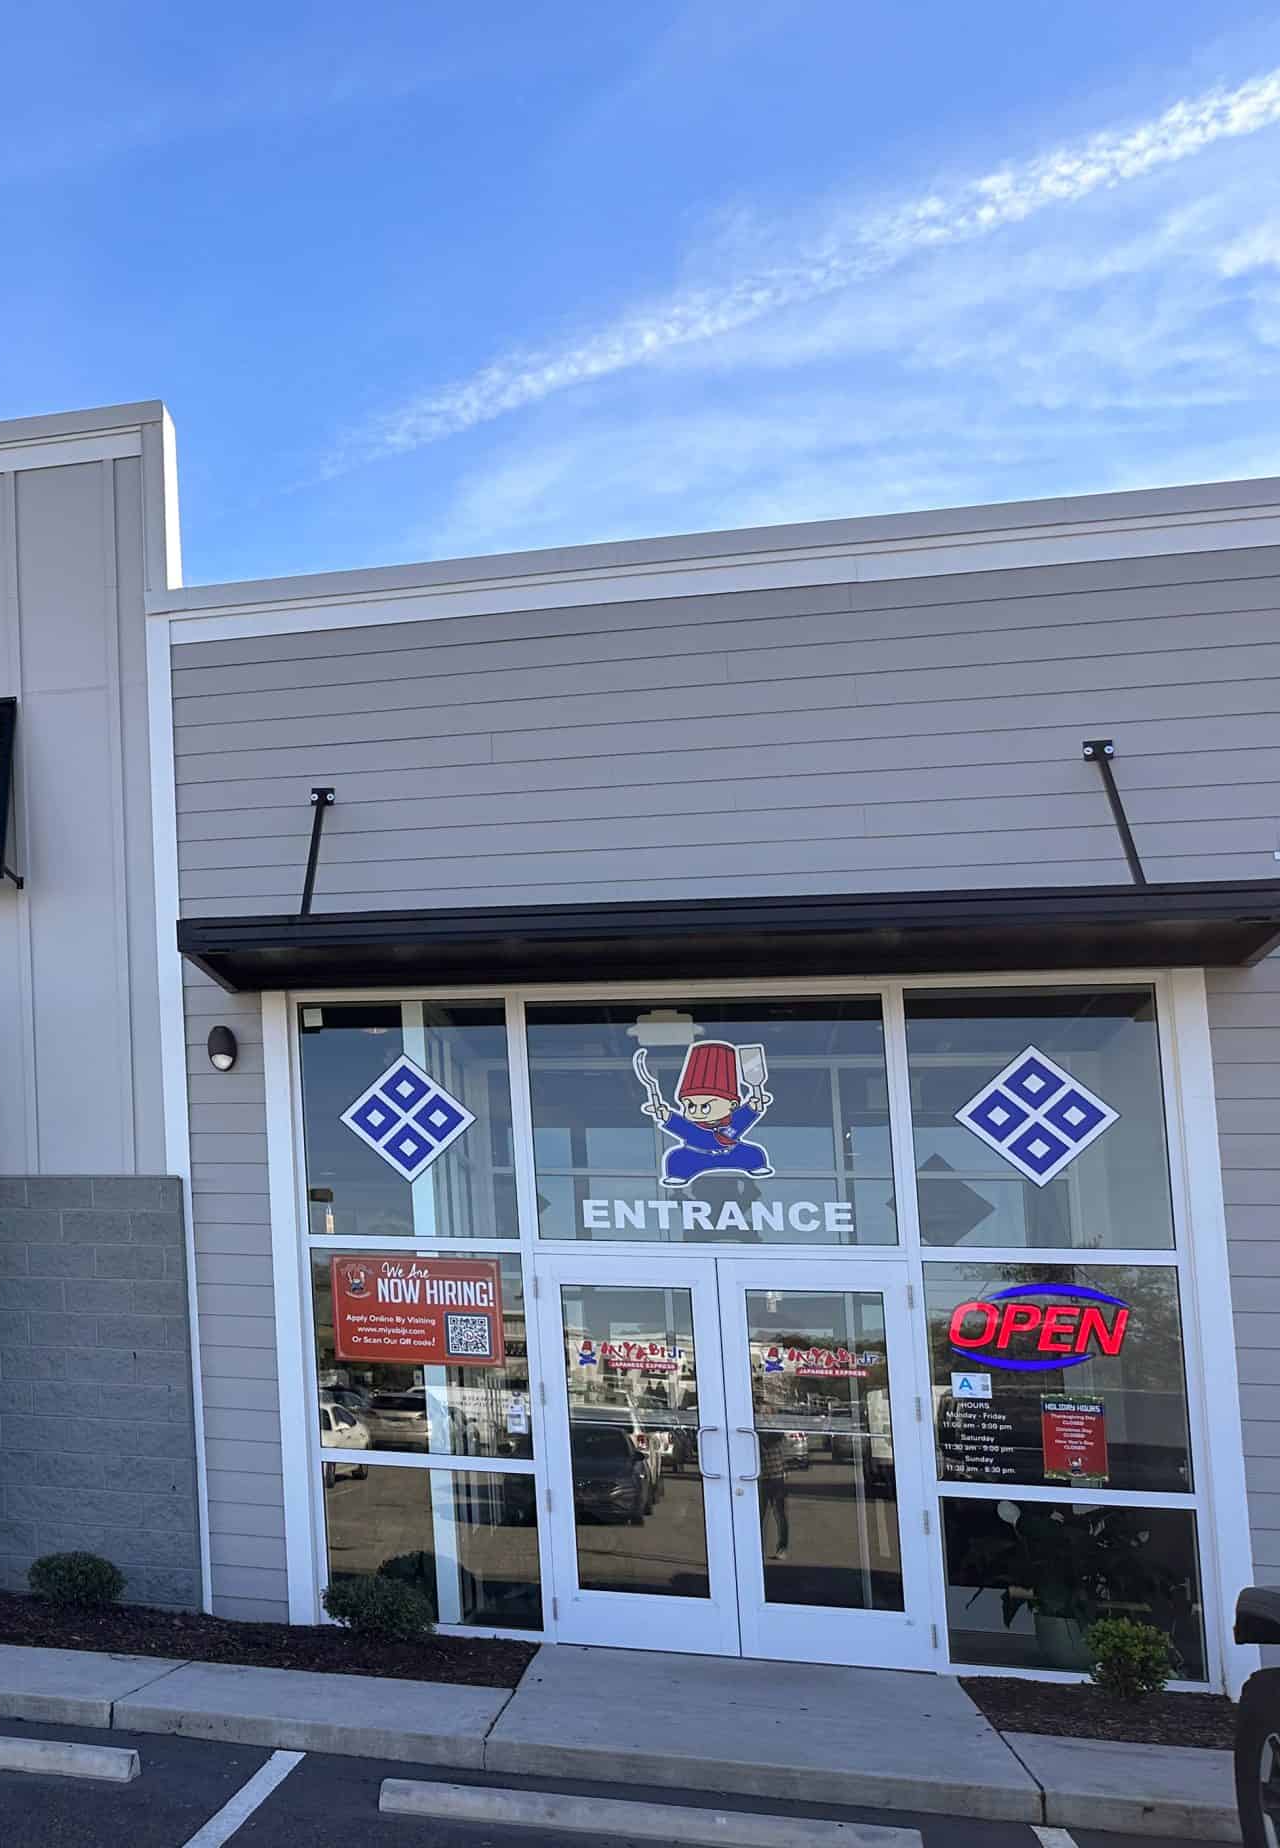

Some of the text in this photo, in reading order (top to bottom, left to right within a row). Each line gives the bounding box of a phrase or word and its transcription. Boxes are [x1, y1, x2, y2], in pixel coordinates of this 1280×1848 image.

[582, 1199, 855, 1232] ENTRANCE
[382, 1262, 403, 1278] We
[407, 1263, 430, 1279] Are
[377, 1278, 495, 1308] NOW HIRING!
[345, 1314, 436, 1326] Apply Online By Visiting
[949, 1302, 1129, 1355] OPEN
[351, 1335, 362, 1343] Or
[363, 1336, 382, 1344] Scan
[383, 1337, 398, 1345] Our
[959, 1376, 973, 1390] A
[959, 1401, 990, 1409] HOURS
[946, 1410, 977, 1420] Monday
[983, 1412, 1006, 1421] Friday
[960, 1433, 995, 1443] Saturday
[965, 1455, 994, 1465] Sunday
